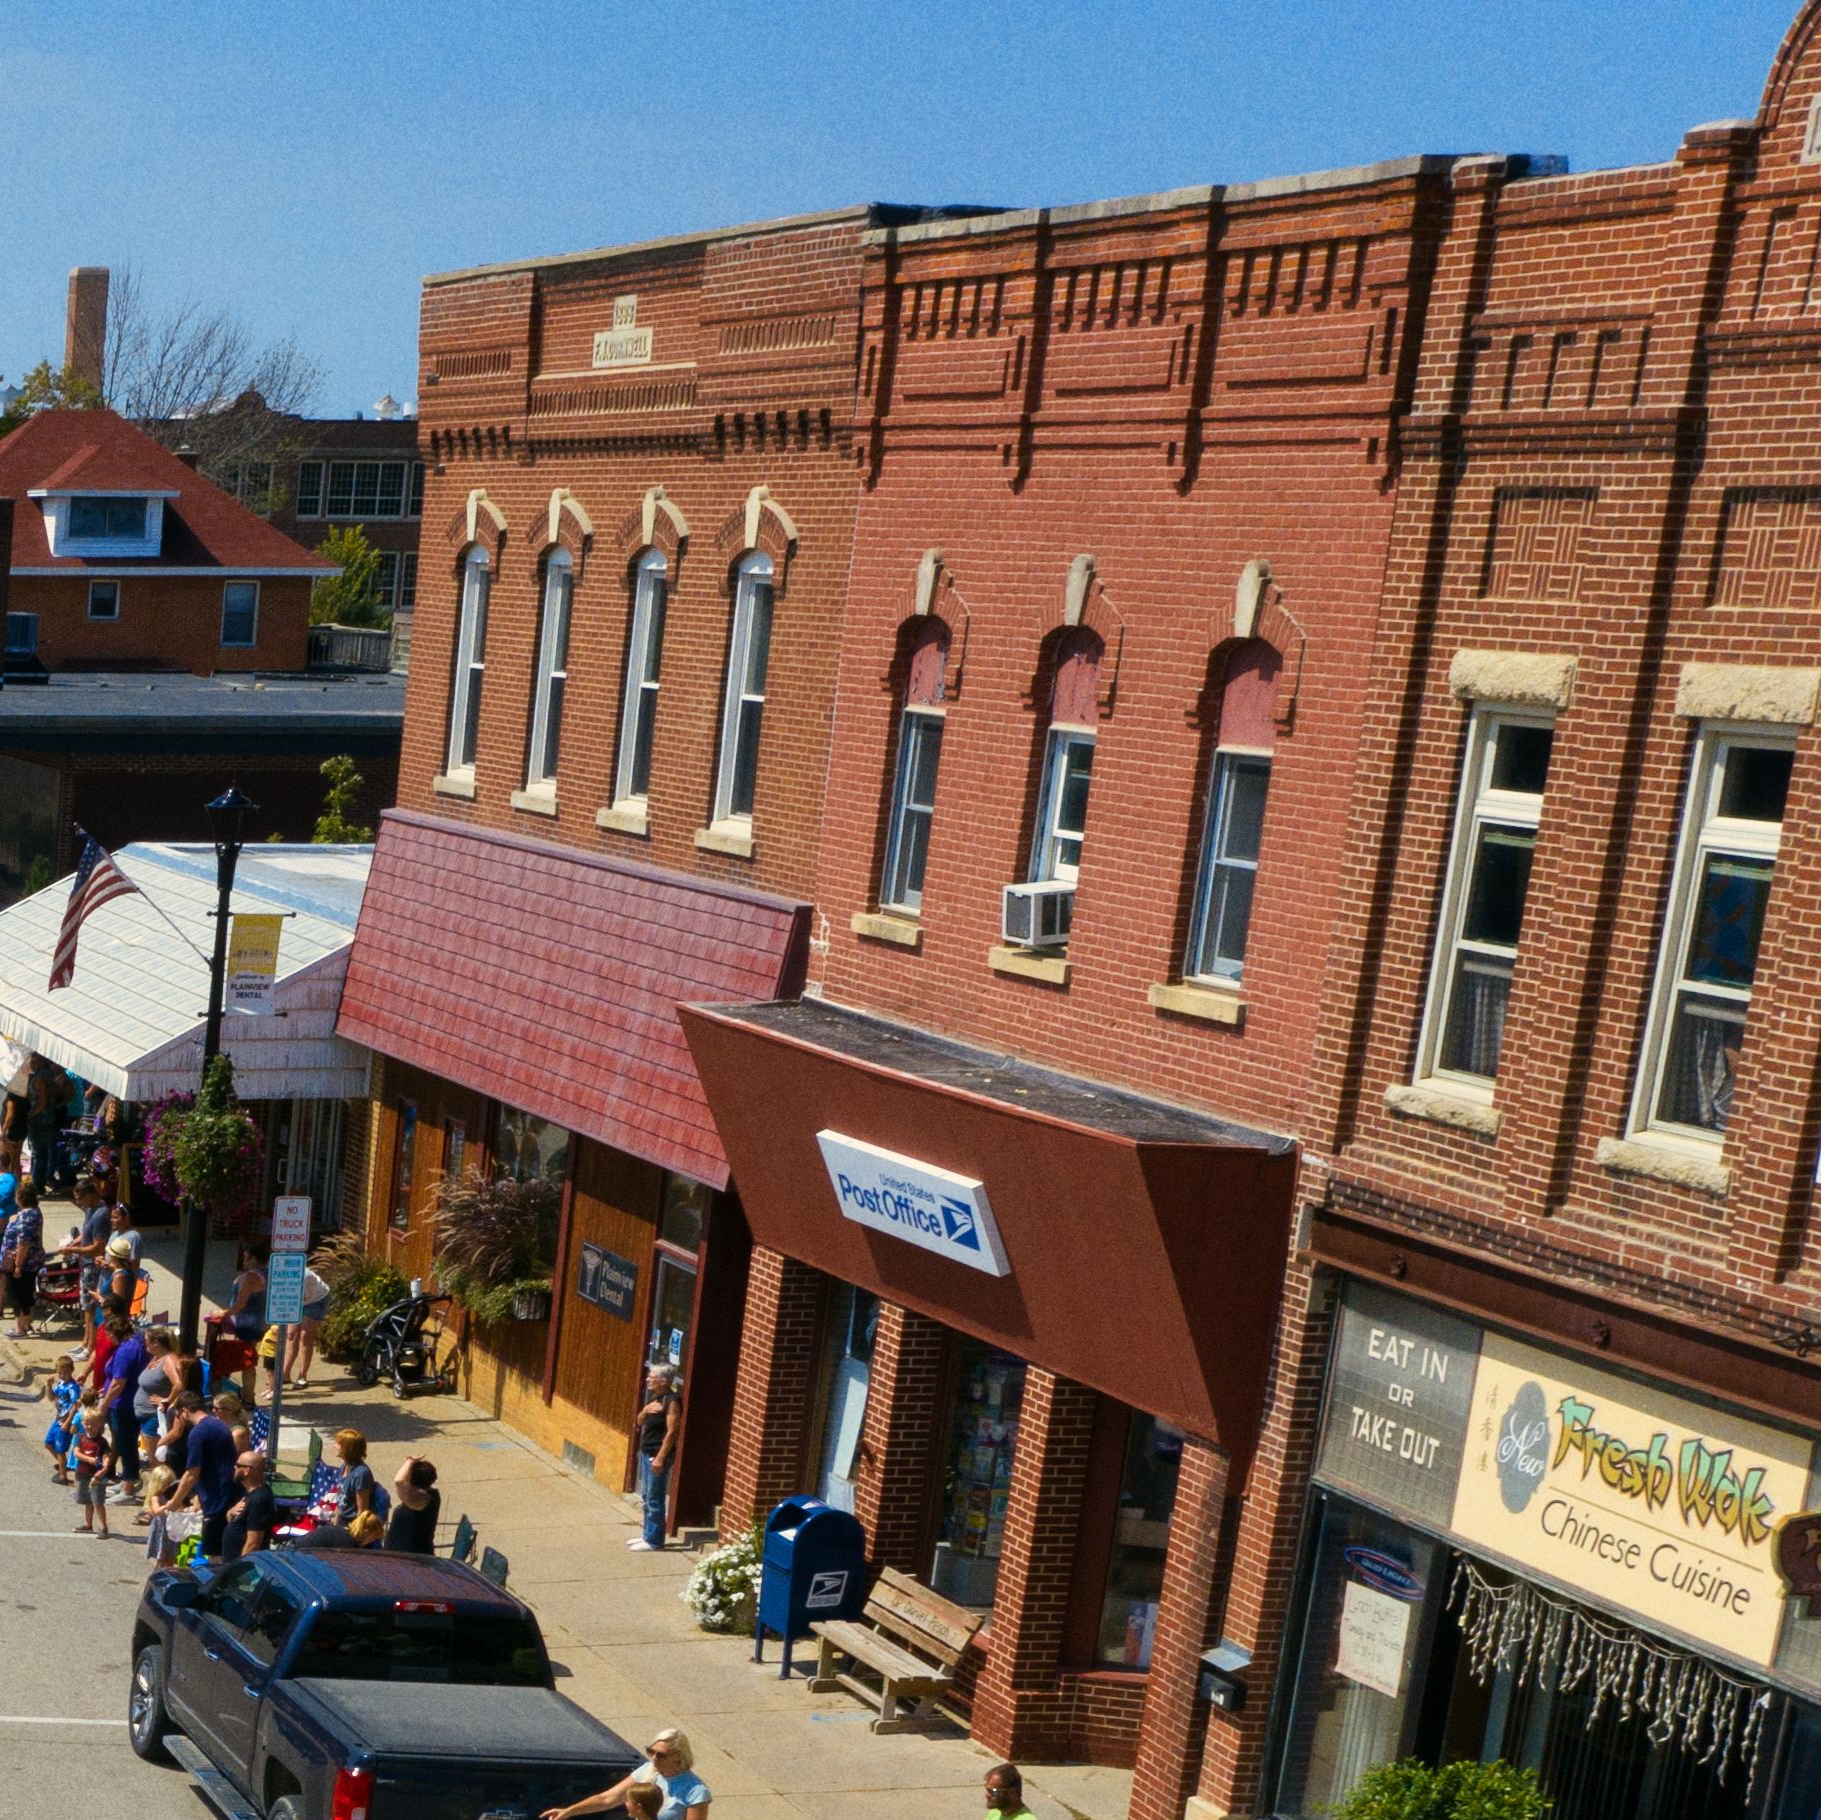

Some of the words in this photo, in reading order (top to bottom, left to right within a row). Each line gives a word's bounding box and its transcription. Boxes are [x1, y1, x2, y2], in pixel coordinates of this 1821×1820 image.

[230, 983, 270, 991] PLAINVIEW
[879, 1173, 908, 1191] United
[907, 1181, 935, 1203] States
[286, 1206, 298, 1214] NO
[837, 1173, 884, 1216] Post
[882, 1190, 943, 1238] Office
[280, 1220, 304, 1229] TRUCK
[274, 1270, 302, 1278] PARKING
[602, 1261, 634, 1290] Plainview
[600, 1281, 624, 1307] Dental
[1368, 1328, 1415, 1369] EAT
[1421, 1347, 1448, 1384] IN
[1388, 1383, 1414, 1408] OR
[1351, 1406, 1397, 1451] TAKE
[1399, 1427, 1440, 1469] OUT
[1497, 1410, 1546, 1477] New
[1552, 1396, 1673, 1513] Fresh
[1677, 1437, 1774, 1547] Wok
[1541, 1499, 1641, 1570] Chinese
[1649, 1543, 1750, 1616] Cuisine
[1382, 1567, 1411, 1586] LIGHT
